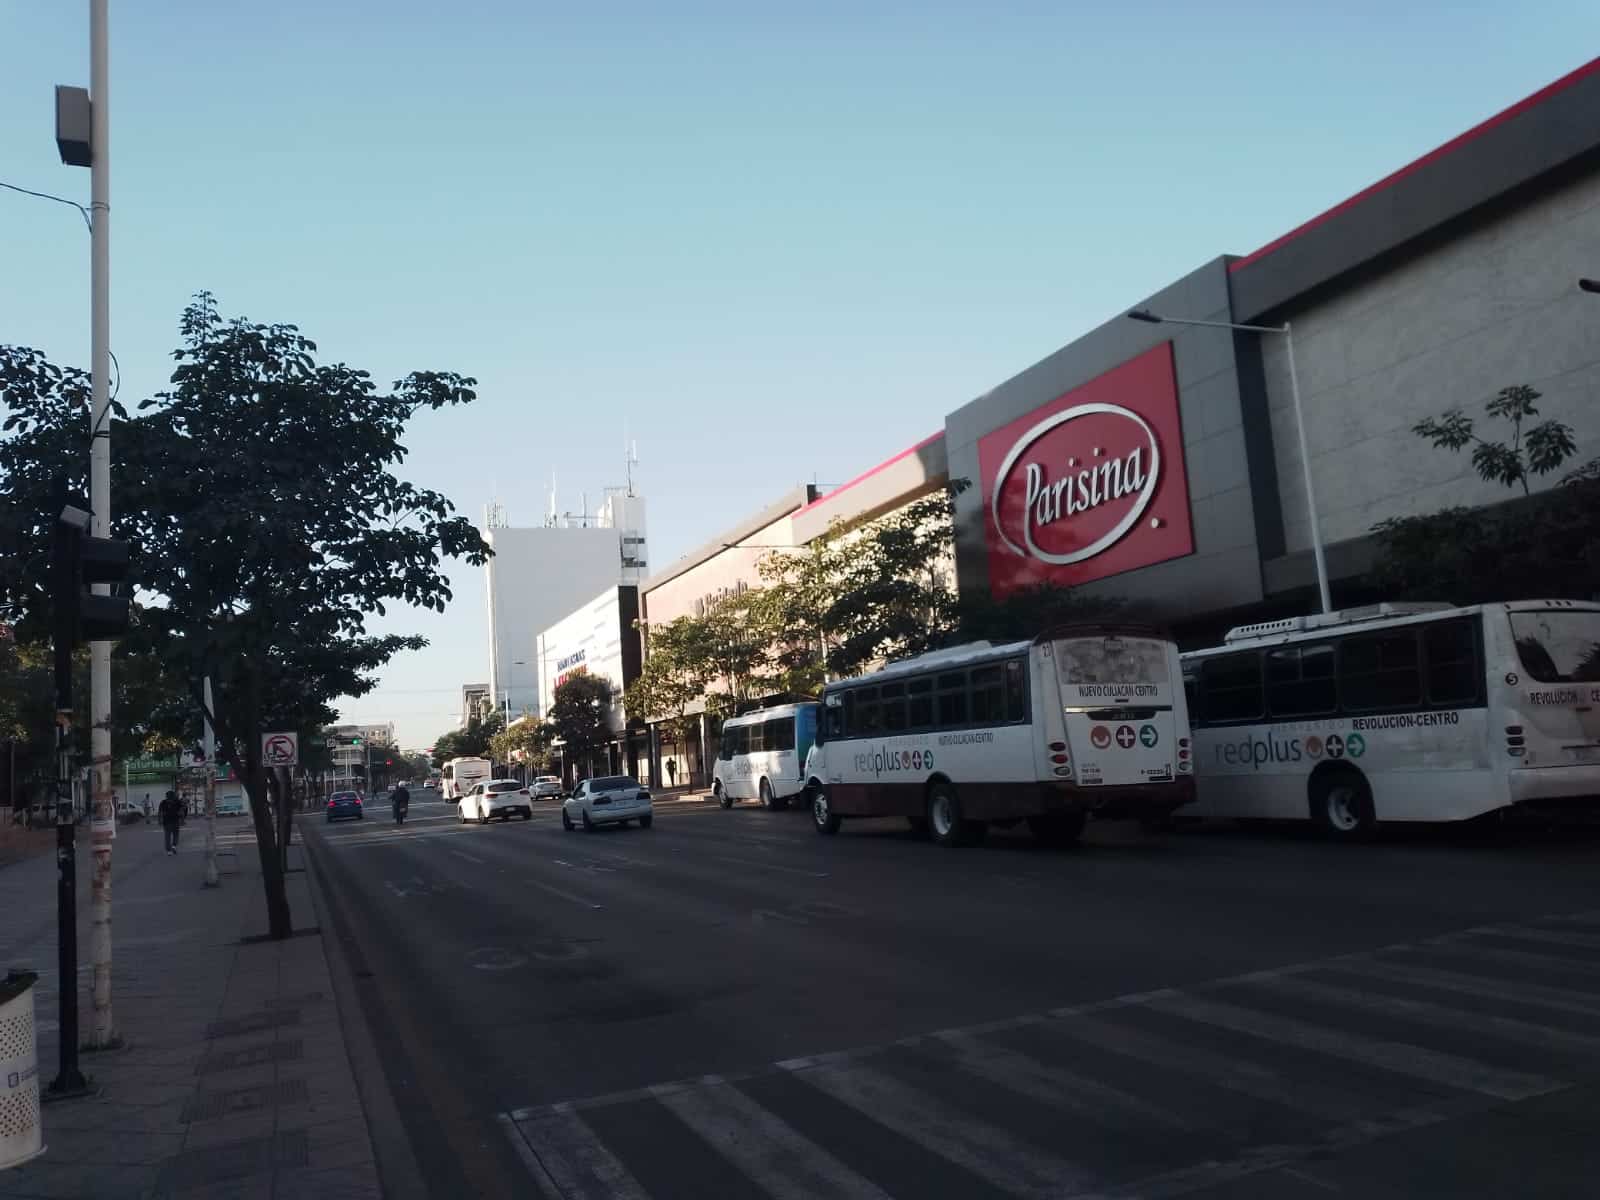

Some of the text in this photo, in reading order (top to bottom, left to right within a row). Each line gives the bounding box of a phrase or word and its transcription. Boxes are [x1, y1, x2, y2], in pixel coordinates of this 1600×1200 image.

[1024, 446, 1147, 528] Parisina
[1078, 684, 1158, 697] NUEVO CULIACAN CENTRO
[854, 744, 902, 779] redplus
[1215, 731, 1303, 771] redplus
